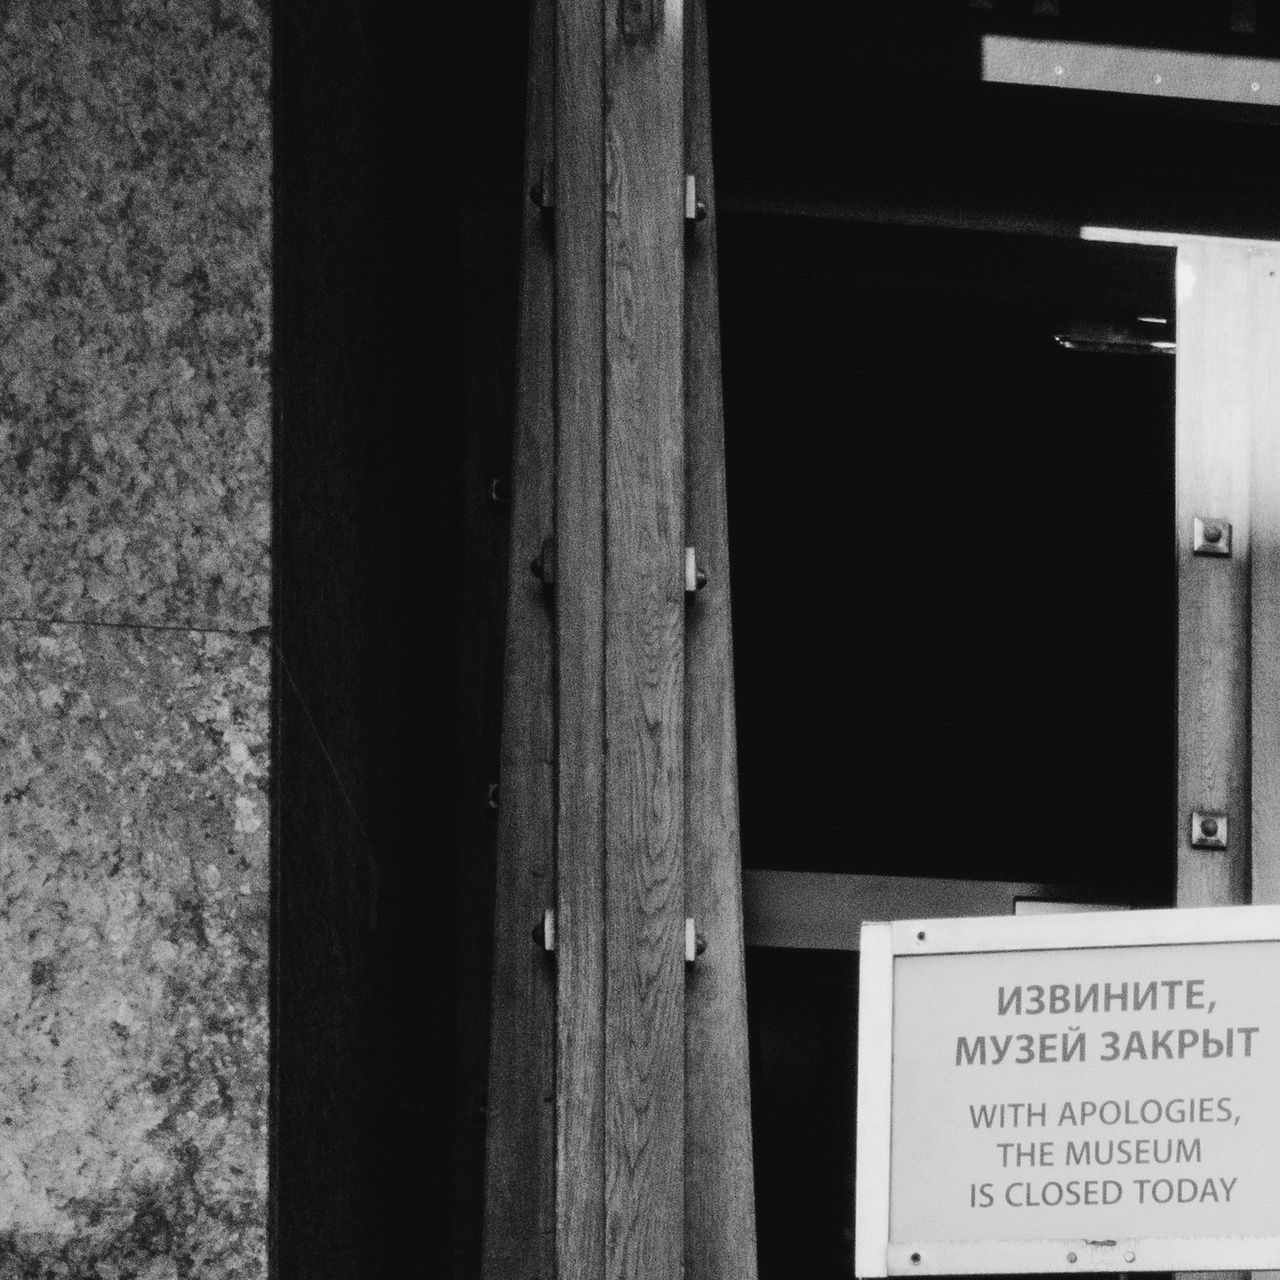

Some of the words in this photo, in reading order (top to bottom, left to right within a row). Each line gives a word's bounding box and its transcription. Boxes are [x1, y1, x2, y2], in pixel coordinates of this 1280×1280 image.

[998, 980, 1216, 1015] ИЗВИНИТЕ,
[955, 1026, 1086, 1066] МУЗЕЙ
[1100, 1027, 1260, 1061] ЗАКРЫТ
[970, 1103, 1047, 1129] WITH
[1058, 1098, 1240, 1127] APOLOGIES,
[997, 1142, 1054, 1168] THE
[1065, 1139, 1202, 1166] MUSEUM
[971, 1183, 995, 1208] IS
[1005, 1180, 1123, 1208] CLOSED
[1133, 1178, 1238, 1205] TODAY
